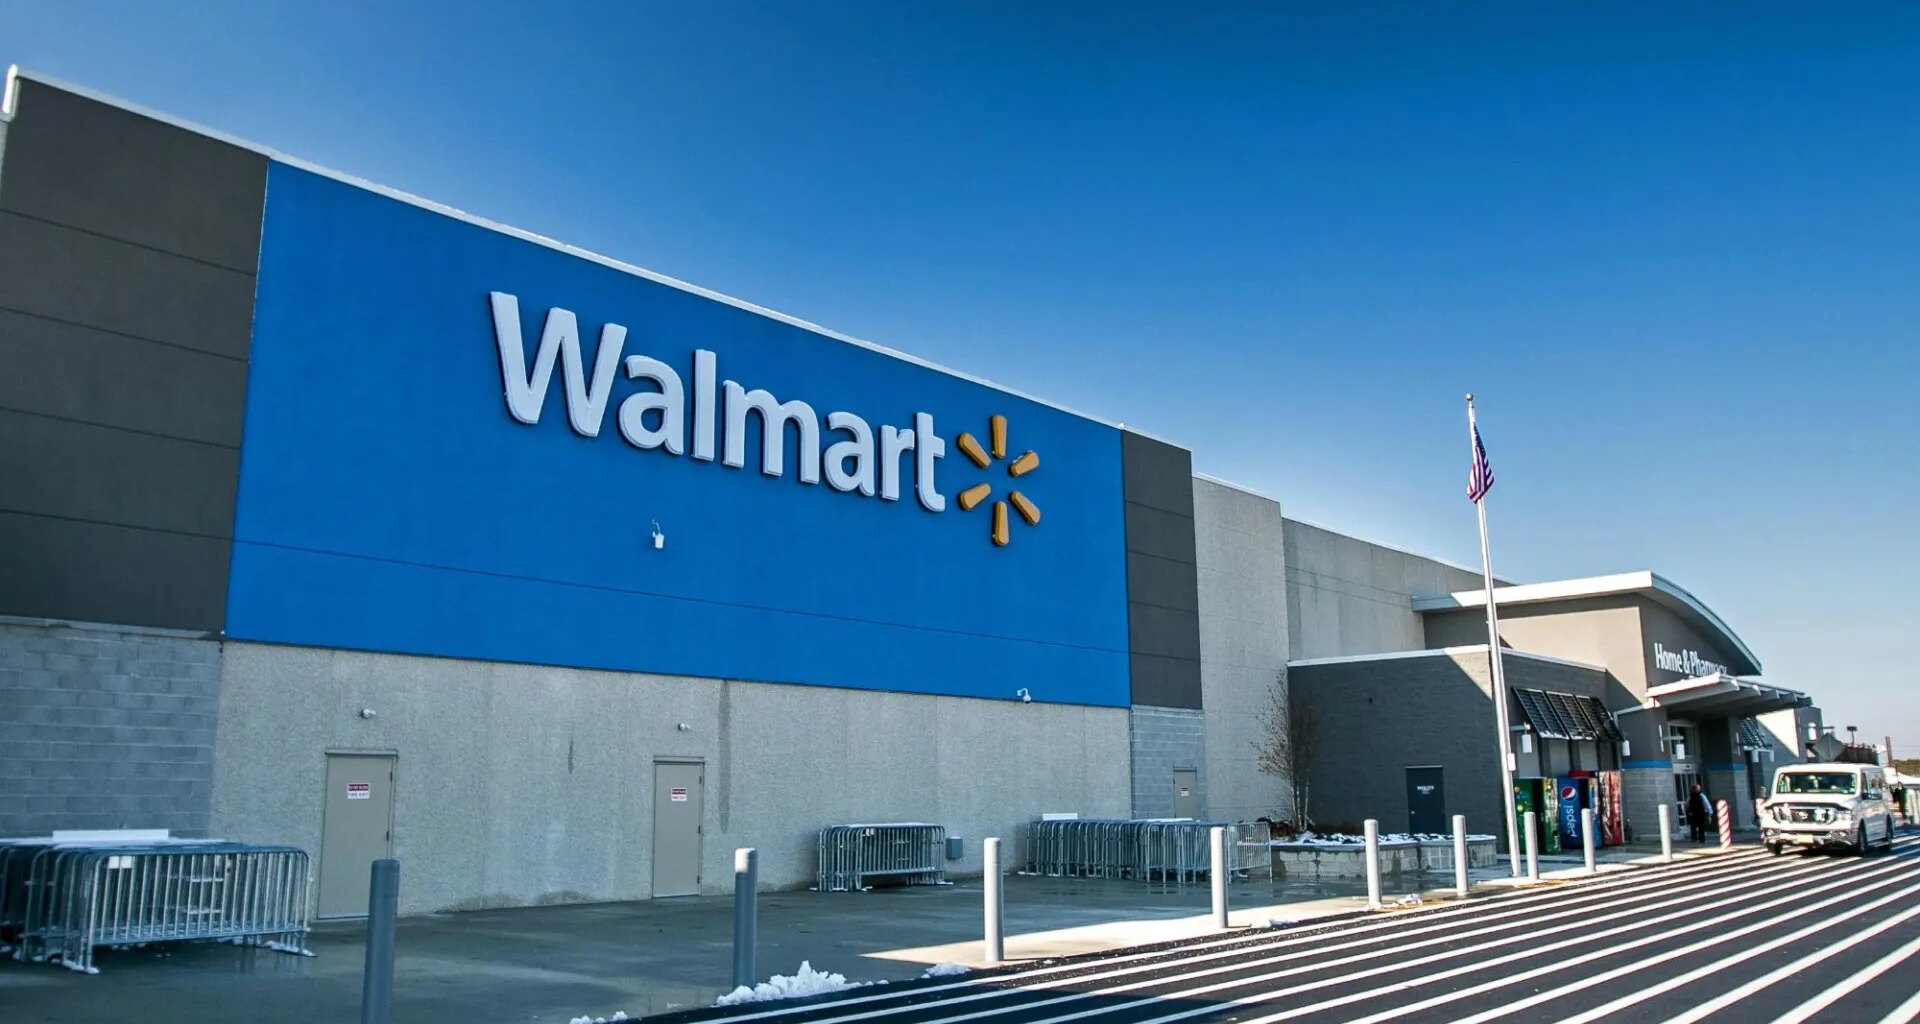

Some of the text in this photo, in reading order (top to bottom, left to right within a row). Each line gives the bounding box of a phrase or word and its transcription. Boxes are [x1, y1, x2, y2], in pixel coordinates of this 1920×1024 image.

[490, 290, 946, 513] Walmart
[1654, 642, 1683, 673] Home
[1682, 649, 1692, 675] &
[1563, 804, 1579, 838] pepsi
